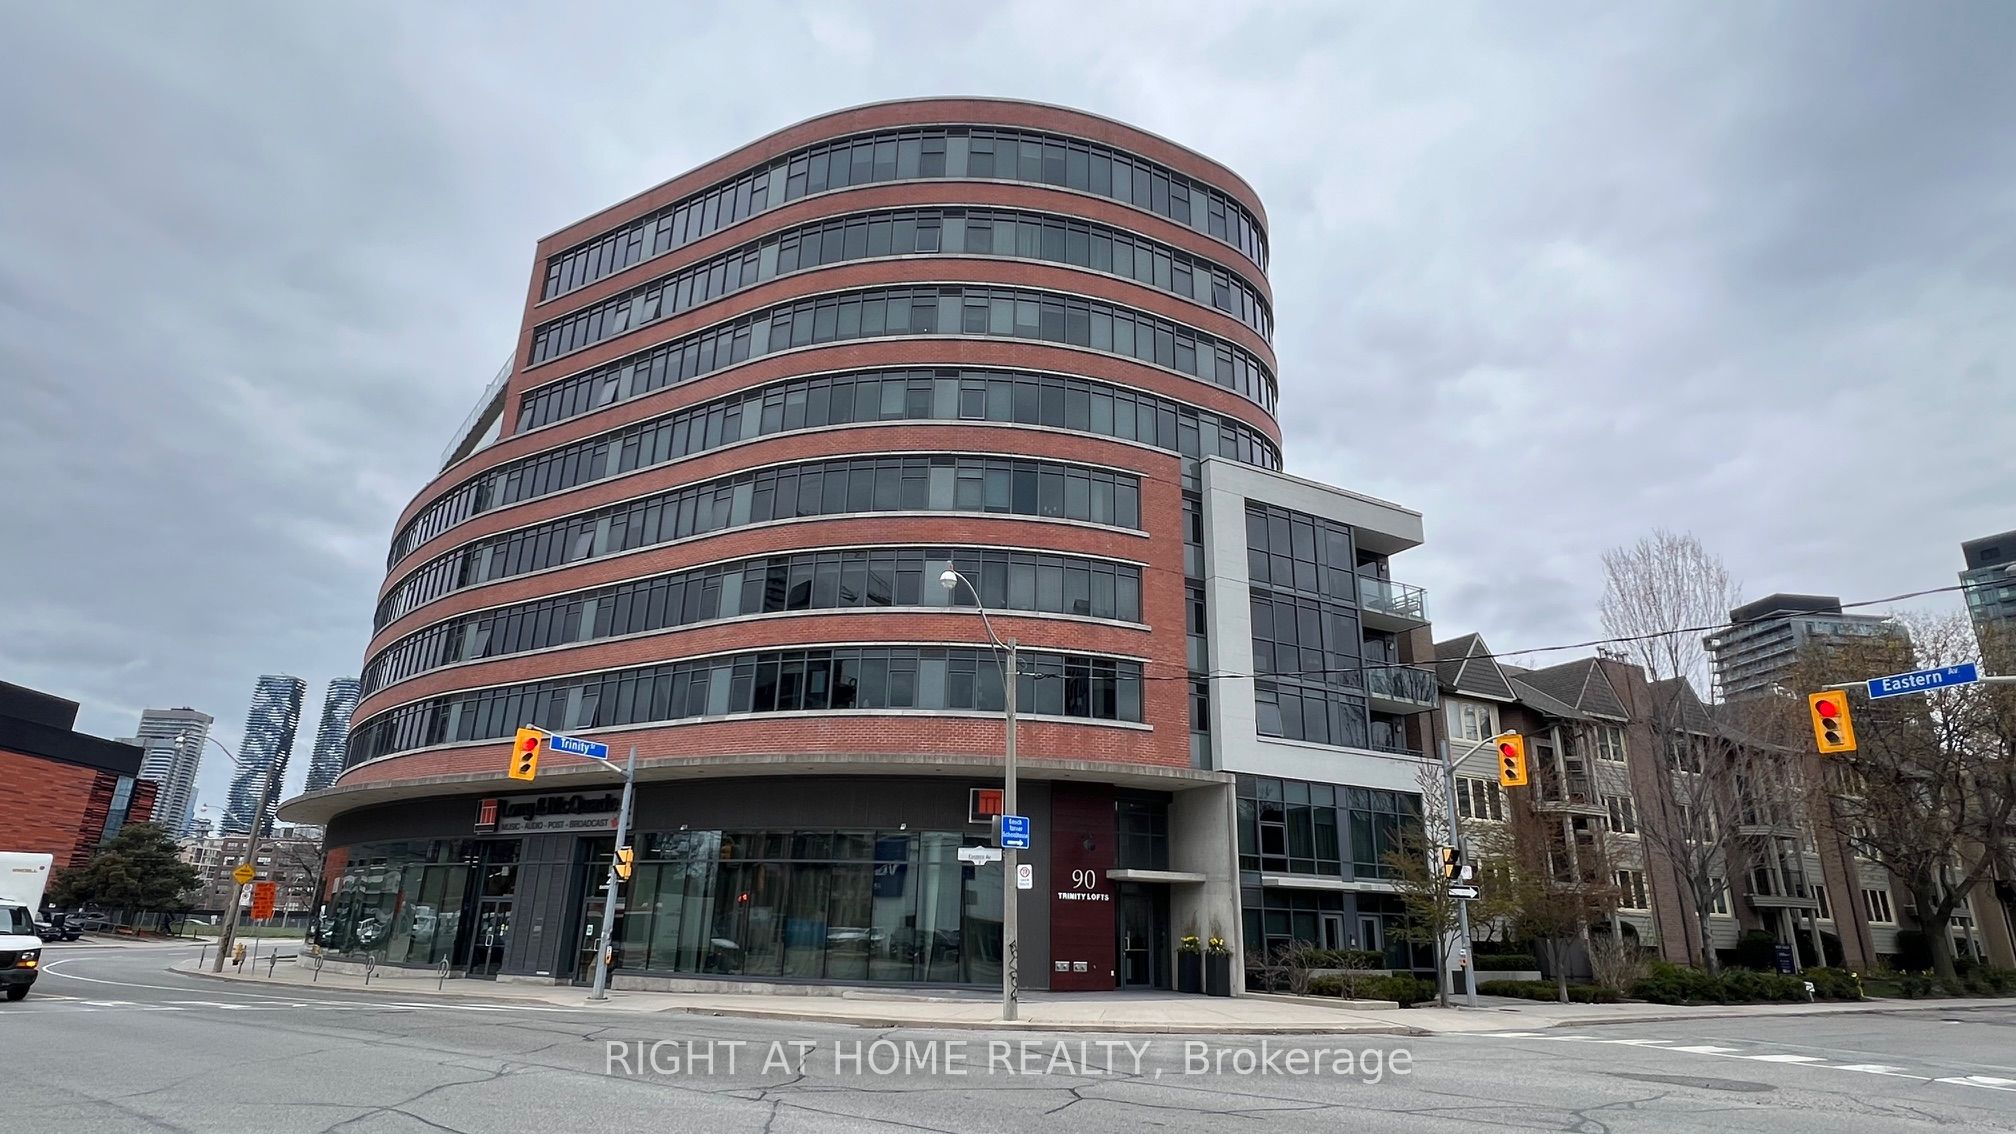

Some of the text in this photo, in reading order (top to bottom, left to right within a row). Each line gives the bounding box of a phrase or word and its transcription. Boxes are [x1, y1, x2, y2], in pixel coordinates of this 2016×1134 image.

[1882, 672, 1943, 692] Eastern
[561, 737, 590, 755] Trinity
[501, 821, 520, 831] MUSIC
[524, 821, 543, 830] AUDIO
[548, 820, 564, 829] POST
[569, 818, 609, 828] BROADCAST
[1072, 869, 1096, 890] 90
[1058, 892, 1109, 901] TRINITY LOFTS
